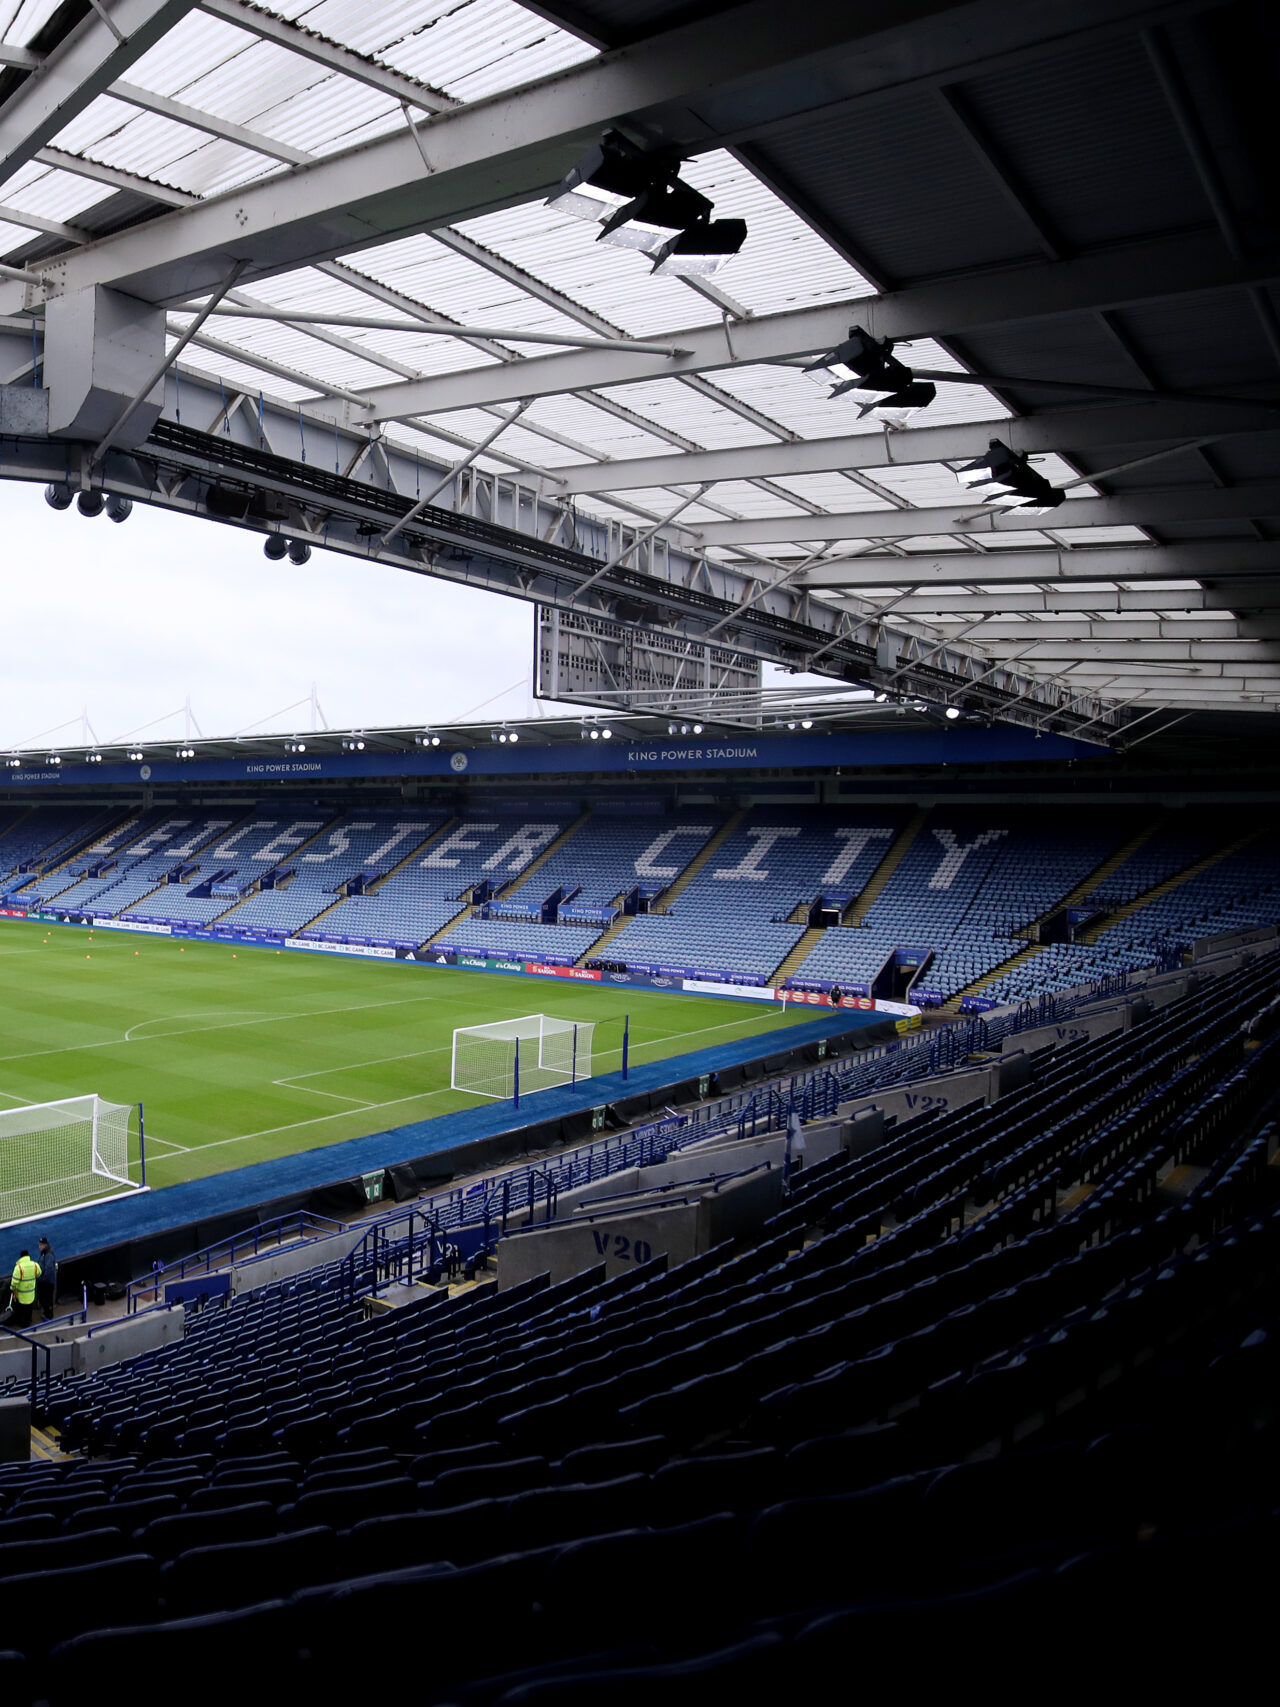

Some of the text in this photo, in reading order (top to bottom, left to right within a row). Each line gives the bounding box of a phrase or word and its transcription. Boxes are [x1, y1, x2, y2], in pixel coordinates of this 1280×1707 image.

[628, 748, 757, 760] KING POWER STADIUM
[292, 763, 321, 771] STADIUM
[90, 820, 1008, 889] LEICESTER CITY
[905, 1093, 948, 1113] V22
[592, 1230, 651, 1264] V20
